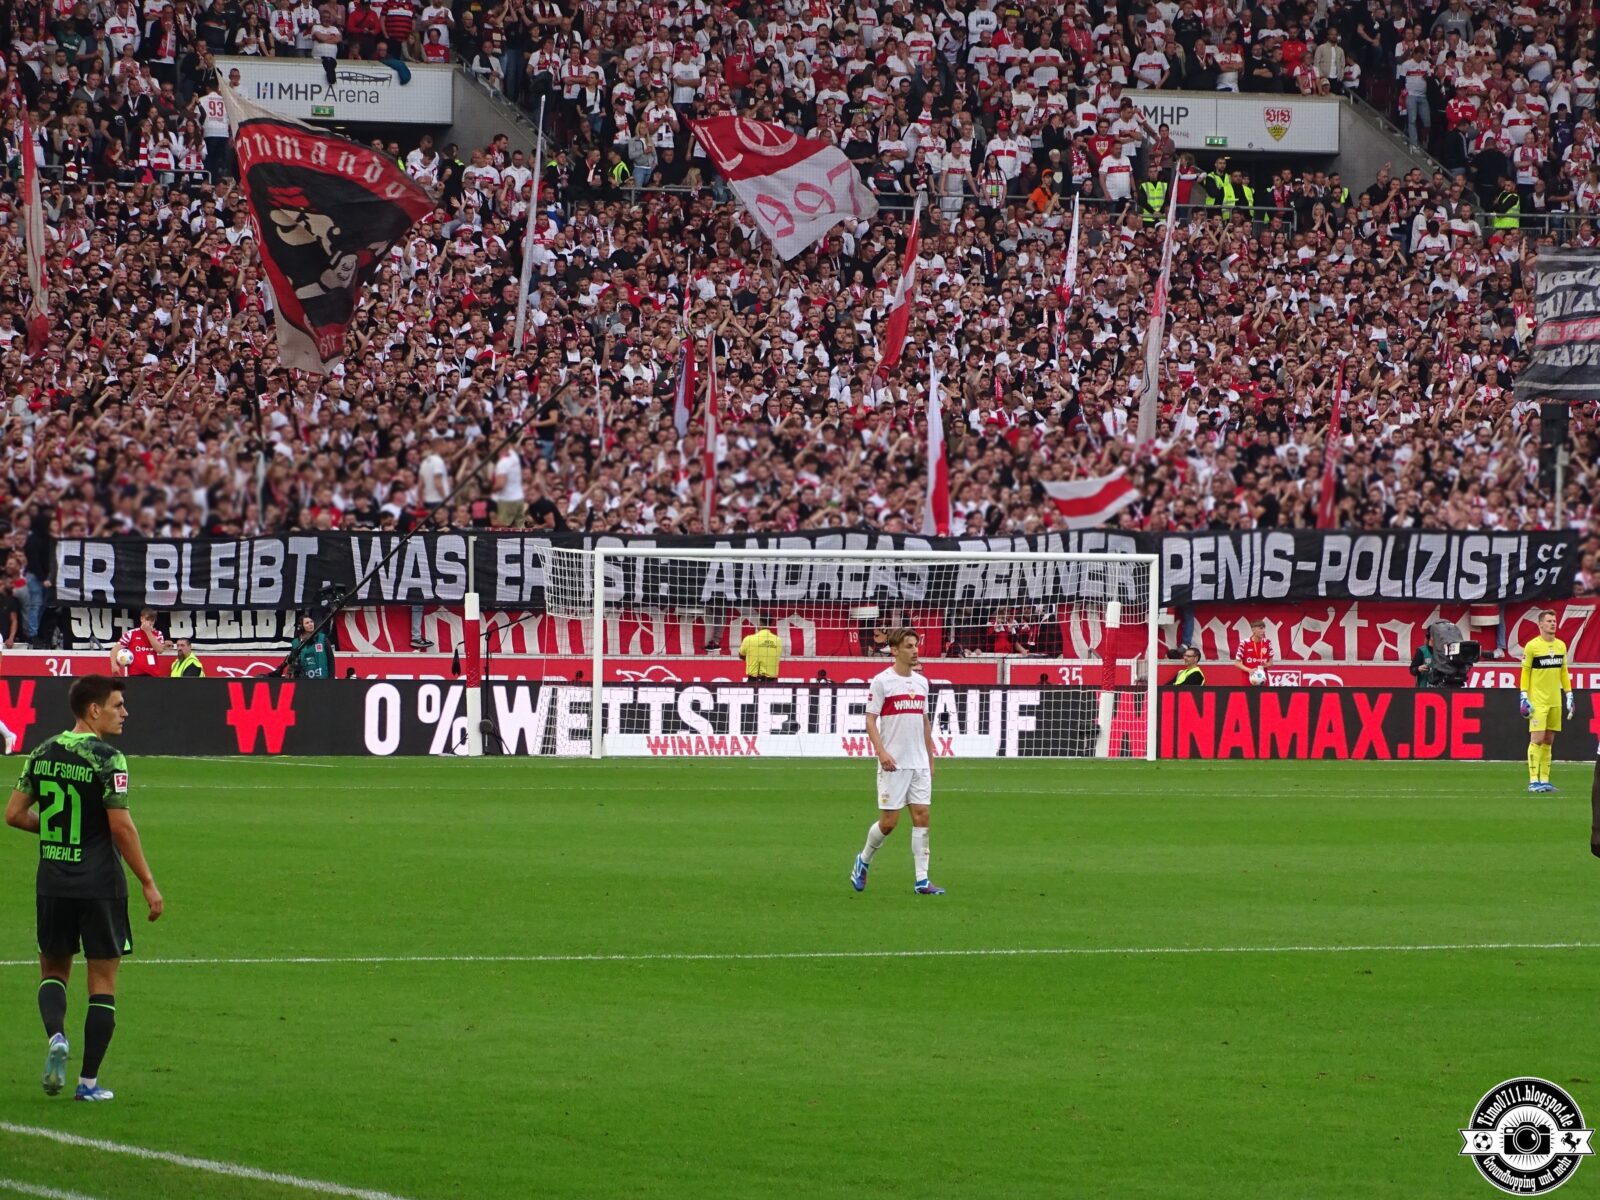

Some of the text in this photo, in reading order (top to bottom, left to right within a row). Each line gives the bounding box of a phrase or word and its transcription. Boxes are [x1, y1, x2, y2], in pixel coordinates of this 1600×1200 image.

[278, 83, 380, 104] MHP Arena
[208, 100, 224, 117] 93
[1143, 104, 1189, 125] MHP
[56, 540, 117, 604] ER
[351, 534, 466, 602] WAS
[495, 537, 554, 602] ER
[701, 533, 931, 602] ANDREAS
[955, 531, 1137, 602] RENNER
[1162, 531, 1528, 602] PENIS-POLIZIST!
[1534, 566, 1562, 586] 97
[46, 659, 73, 677] 34
[1058, 667, 1083, 686] 35
[226, 682, 296, 754] W
[492, 685, 872, 757] WETTSTEUE
[932, 689, 1041, 758] AUF
[646, 735, 761, 756] WINAMAX
[34, 760, 93, 784] WOLFSBURG
[39, 780, 82, 845] 21
